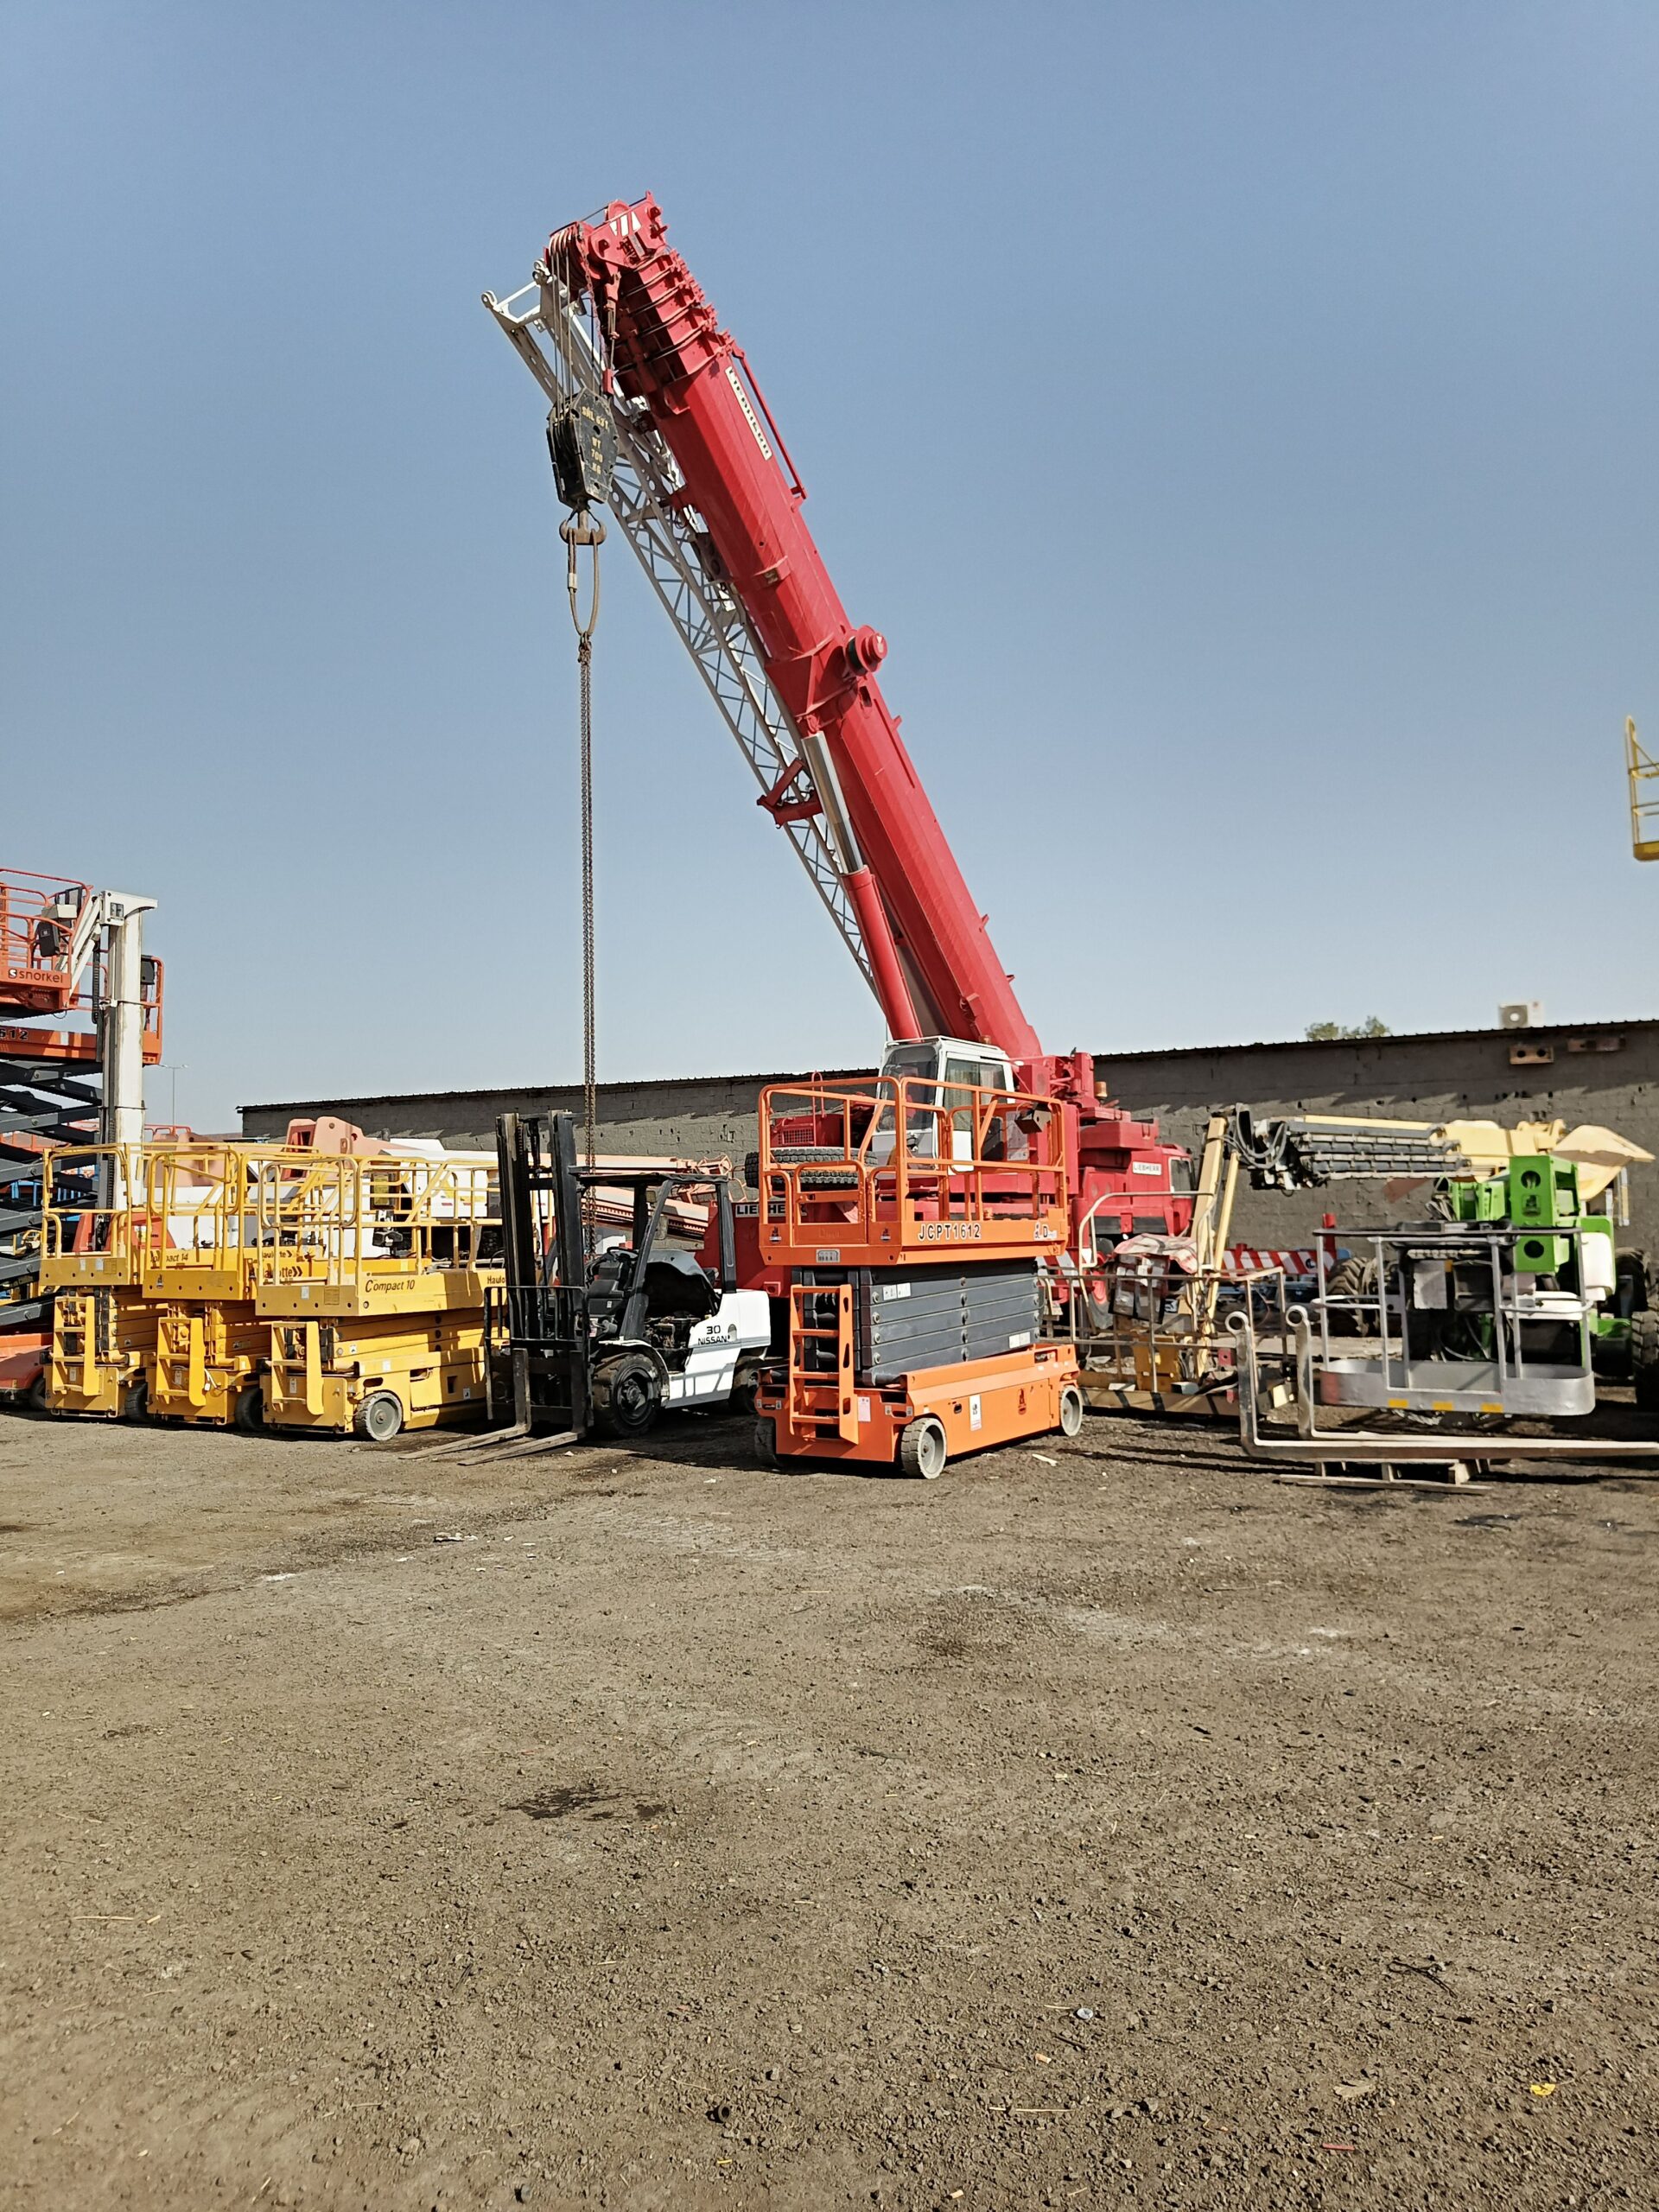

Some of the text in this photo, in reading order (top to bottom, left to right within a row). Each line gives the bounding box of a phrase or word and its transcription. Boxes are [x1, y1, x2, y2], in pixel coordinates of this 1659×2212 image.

[19, 969, 63, 983] snorkel
[918, 1224, 981, 1240] JCPT1612
[487, 1275, 505, 1284] Haulo
[365, 1280, 415, 1294] Compact 10
[706, 1325, 721, 1335] 30
[697, 1335, 728, 1345] NISSAN
